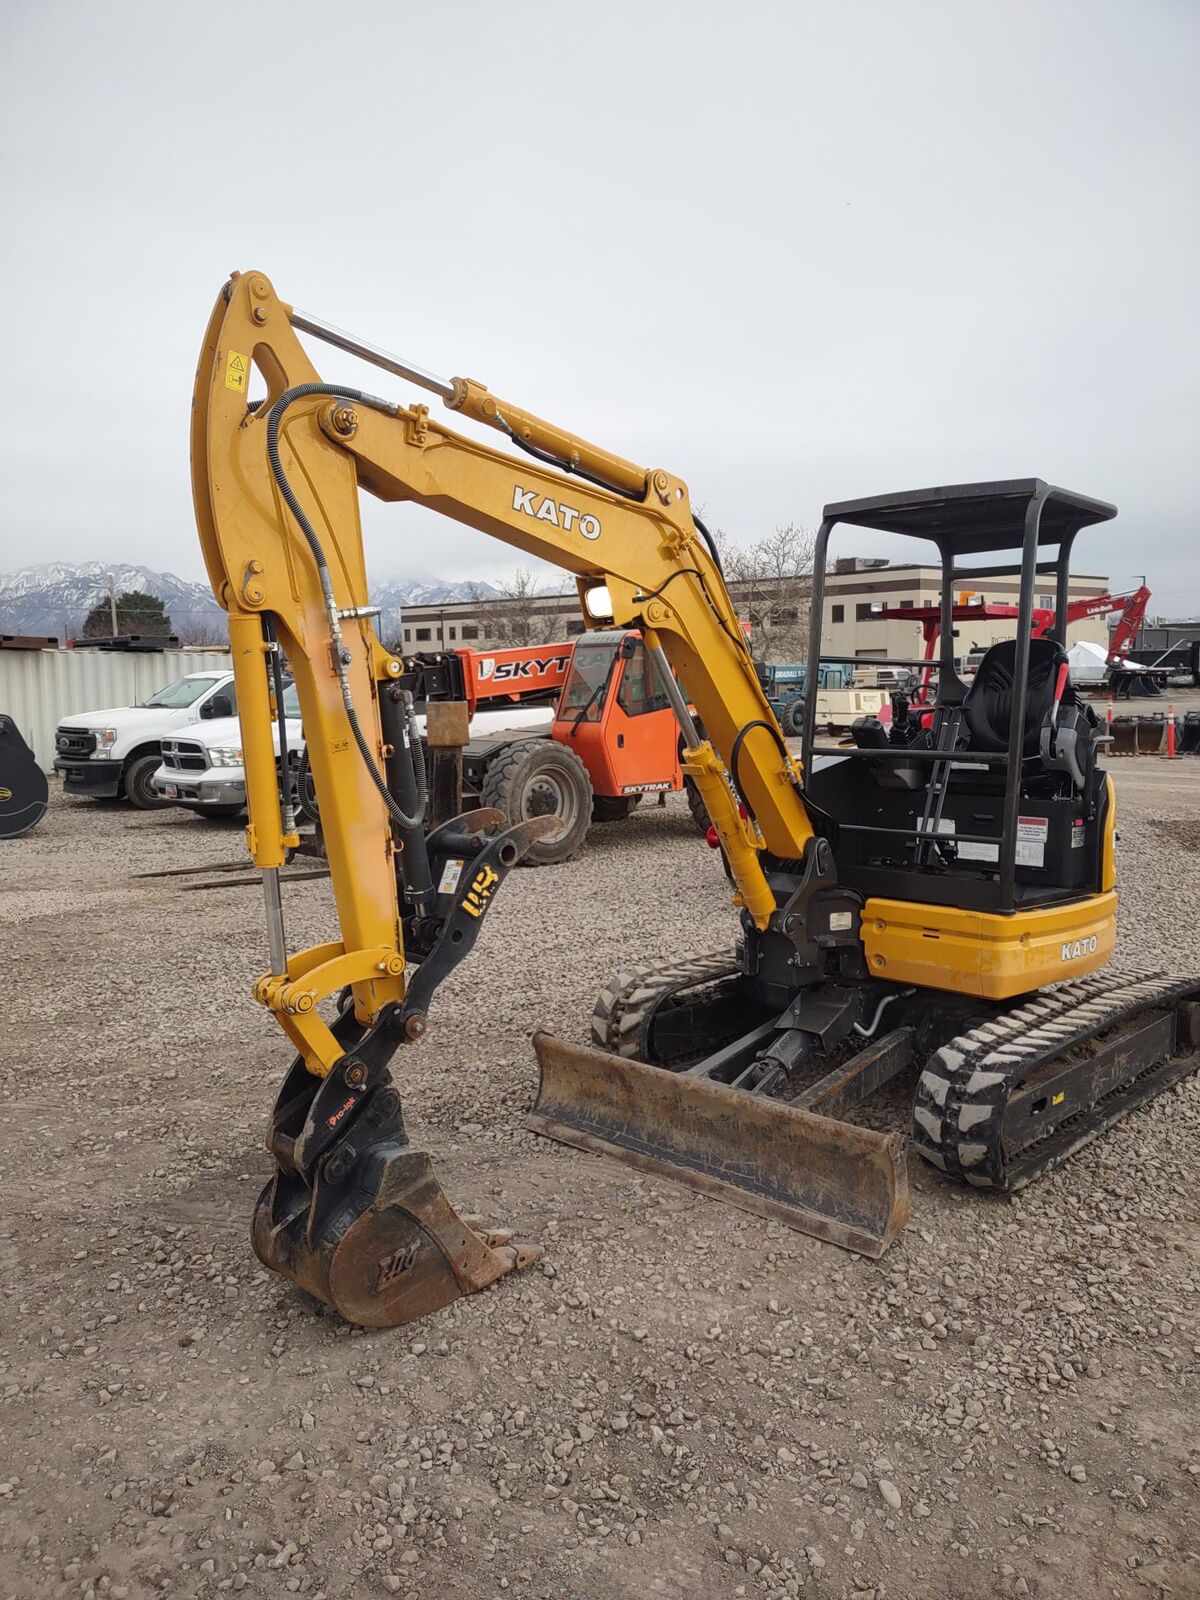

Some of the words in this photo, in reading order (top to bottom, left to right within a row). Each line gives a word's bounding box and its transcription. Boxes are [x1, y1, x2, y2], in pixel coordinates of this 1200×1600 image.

[511, 485, 602, 541] KATO
[623, 782, 671, 795] SKYTRAK
[1061, 935, 1098, 962] KATO
